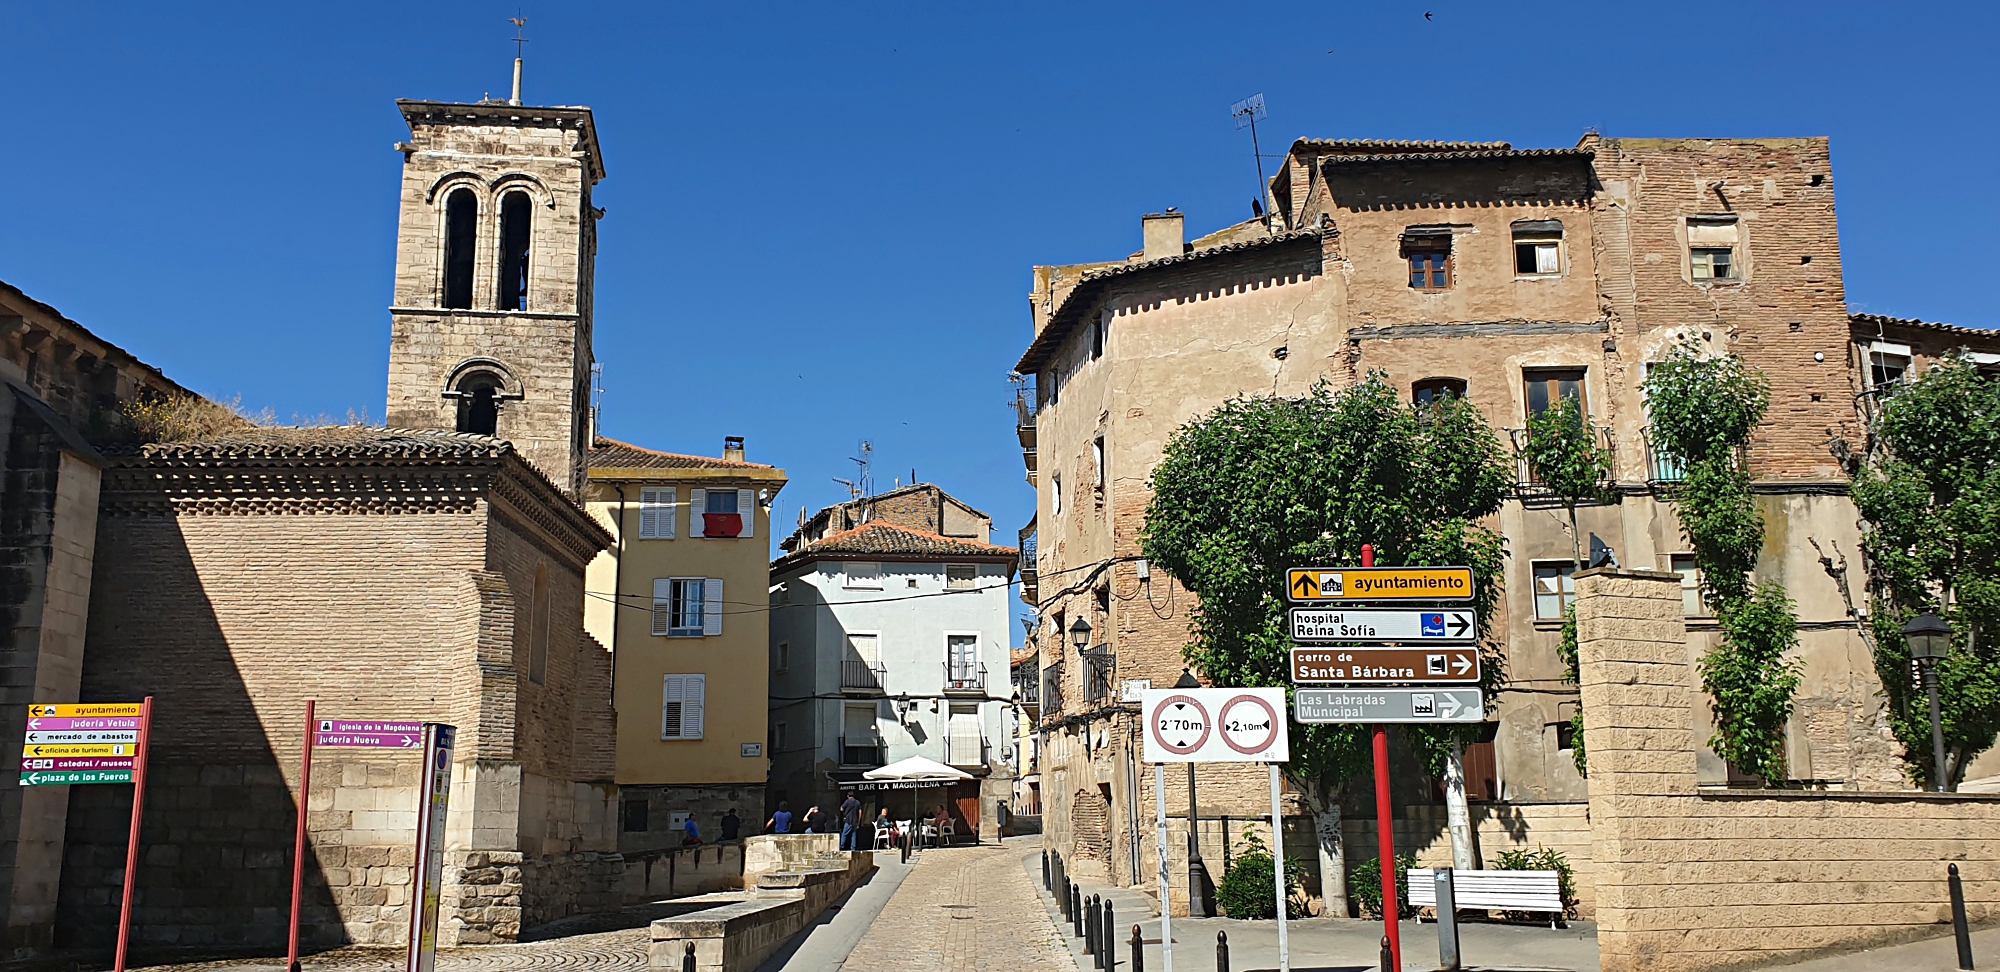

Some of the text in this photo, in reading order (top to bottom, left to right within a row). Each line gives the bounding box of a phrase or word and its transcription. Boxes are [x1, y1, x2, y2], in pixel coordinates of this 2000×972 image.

[1354, 575, 1464, 592] ayuntamiento
[1296, 613, 1344, 625] hospital
[1297, 624, 1376, 636] Reina Sofía
[1297, 653, 1353, 662] cerro de
[1299, 665, 1415, 678] Santa Bárbara
[1300, 693, 1386, 705] Las Labradas
[75, 706, 137, 715] ayuntamiento
[1301, 706, 1364, 719] Municipal
[107, 718, 135, 727] Vetula
[383, 724, 420, 732] Magdalena
[353, 736, 380, 744] Nueva
[41, 772, 130, 783] plaza de los Fueros
[858, 783, 876, 791] BAR
[892, 781, 940, 790] MAGDALENA
